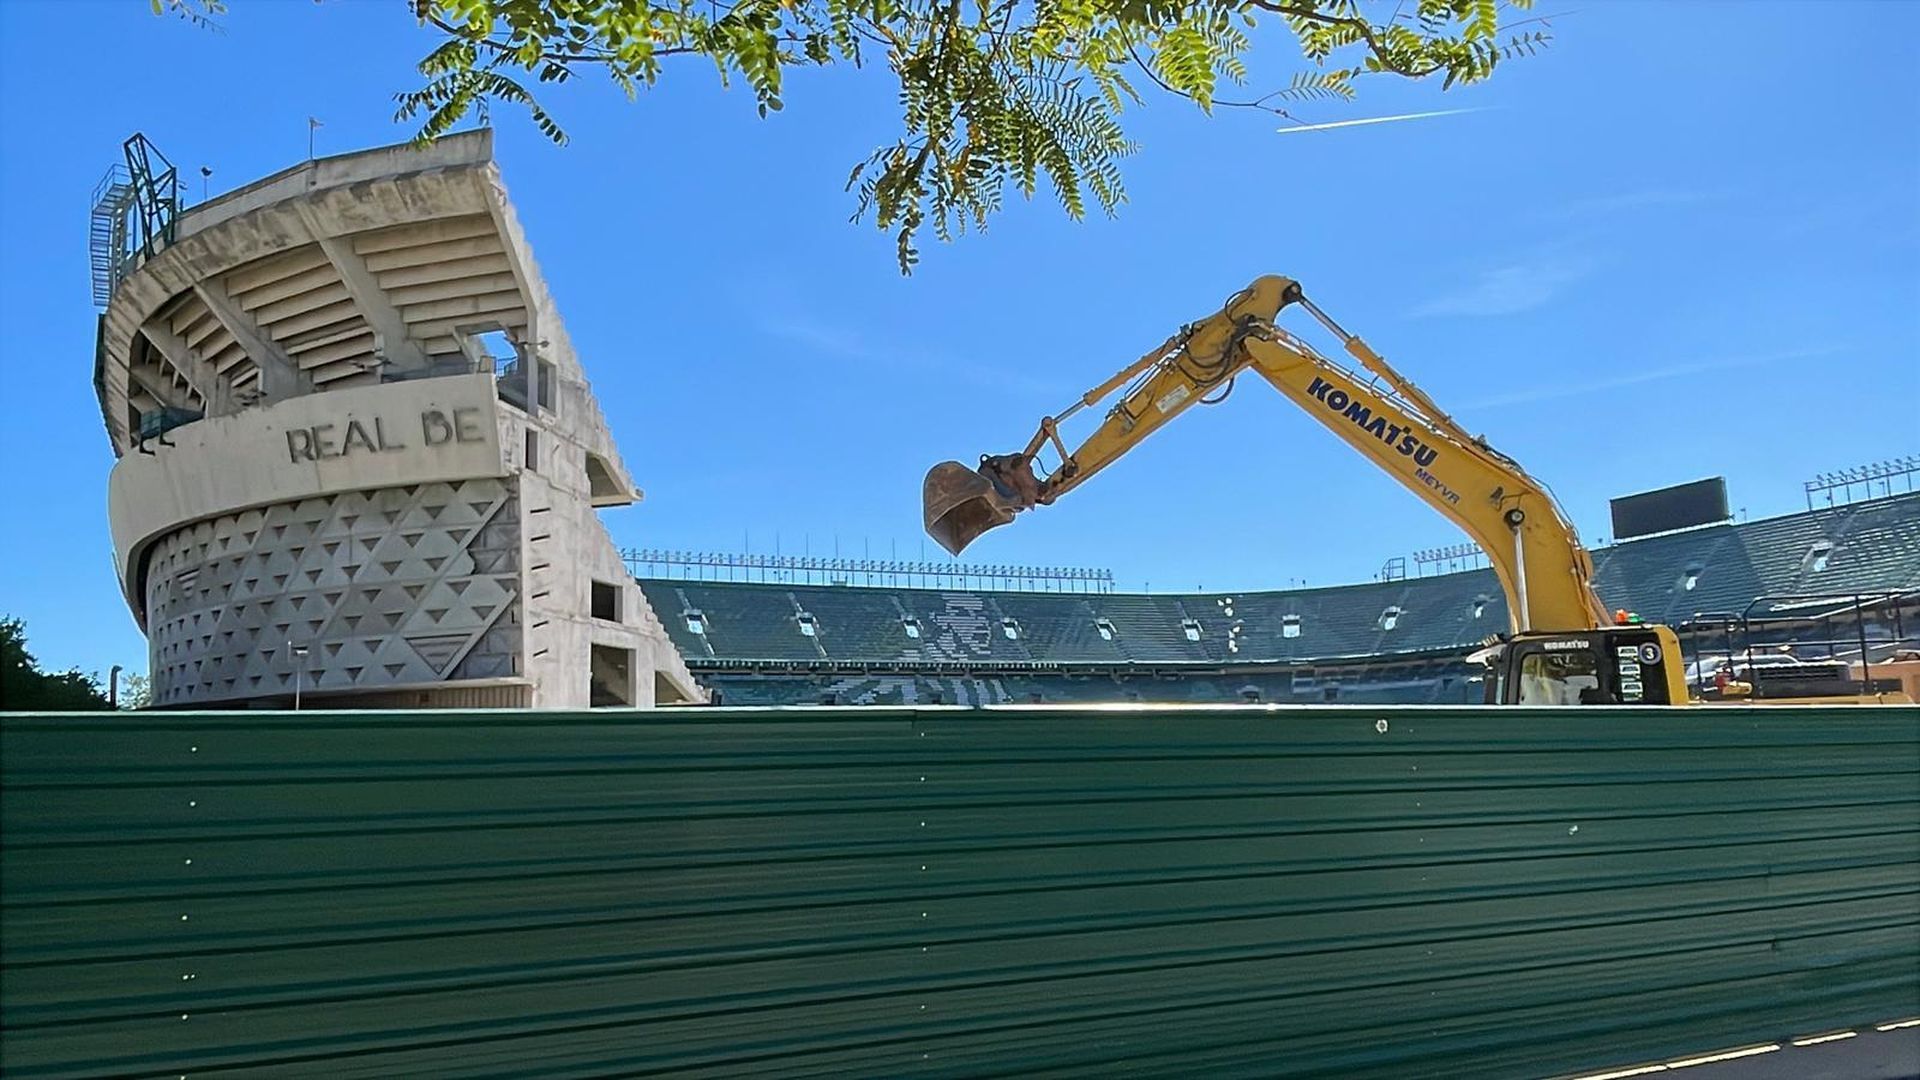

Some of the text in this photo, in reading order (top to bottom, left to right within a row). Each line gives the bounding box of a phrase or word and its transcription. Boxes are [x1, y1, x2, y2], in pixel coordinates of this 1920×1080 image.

[286, 407, 485, 463] REAL BE
[1307, 376, 1438, 467] KOMATSU
[1415, 468, 1460, 504] MEYVR
[1544, 640, 1589, 650] KOMATSU
